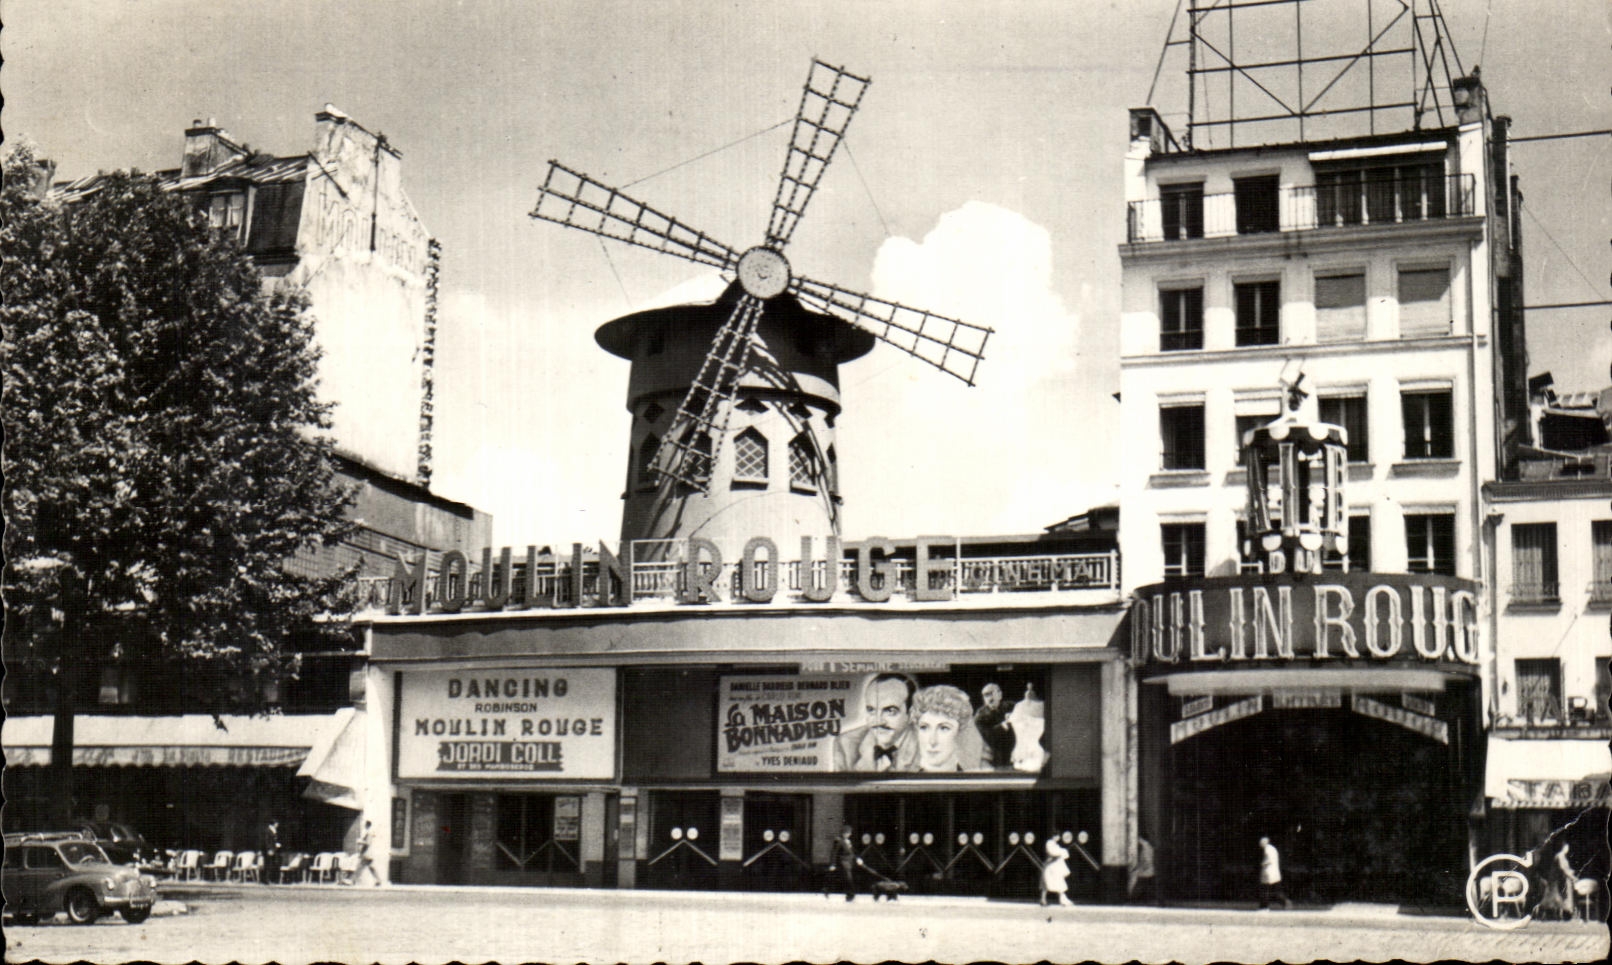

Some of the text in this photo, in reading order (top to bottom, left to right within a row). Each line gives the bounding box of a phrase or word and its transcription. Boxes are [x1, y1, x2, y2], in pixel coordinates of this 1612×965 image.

[386, 536, 955, 616] MOULIN ROUGE
[448, 678, 569, 698] DANCING
[474, 702, 538, 713] ROBINSON
[749, 698, 846, 727] MAISON
[415, 718, 604, 736] MOULIN ROUGE
[723, 719, 842, 753] BONNADIEU
[442, 743, 558, 764] JORDI COLL
[761, 756, 782, 766] YVES
